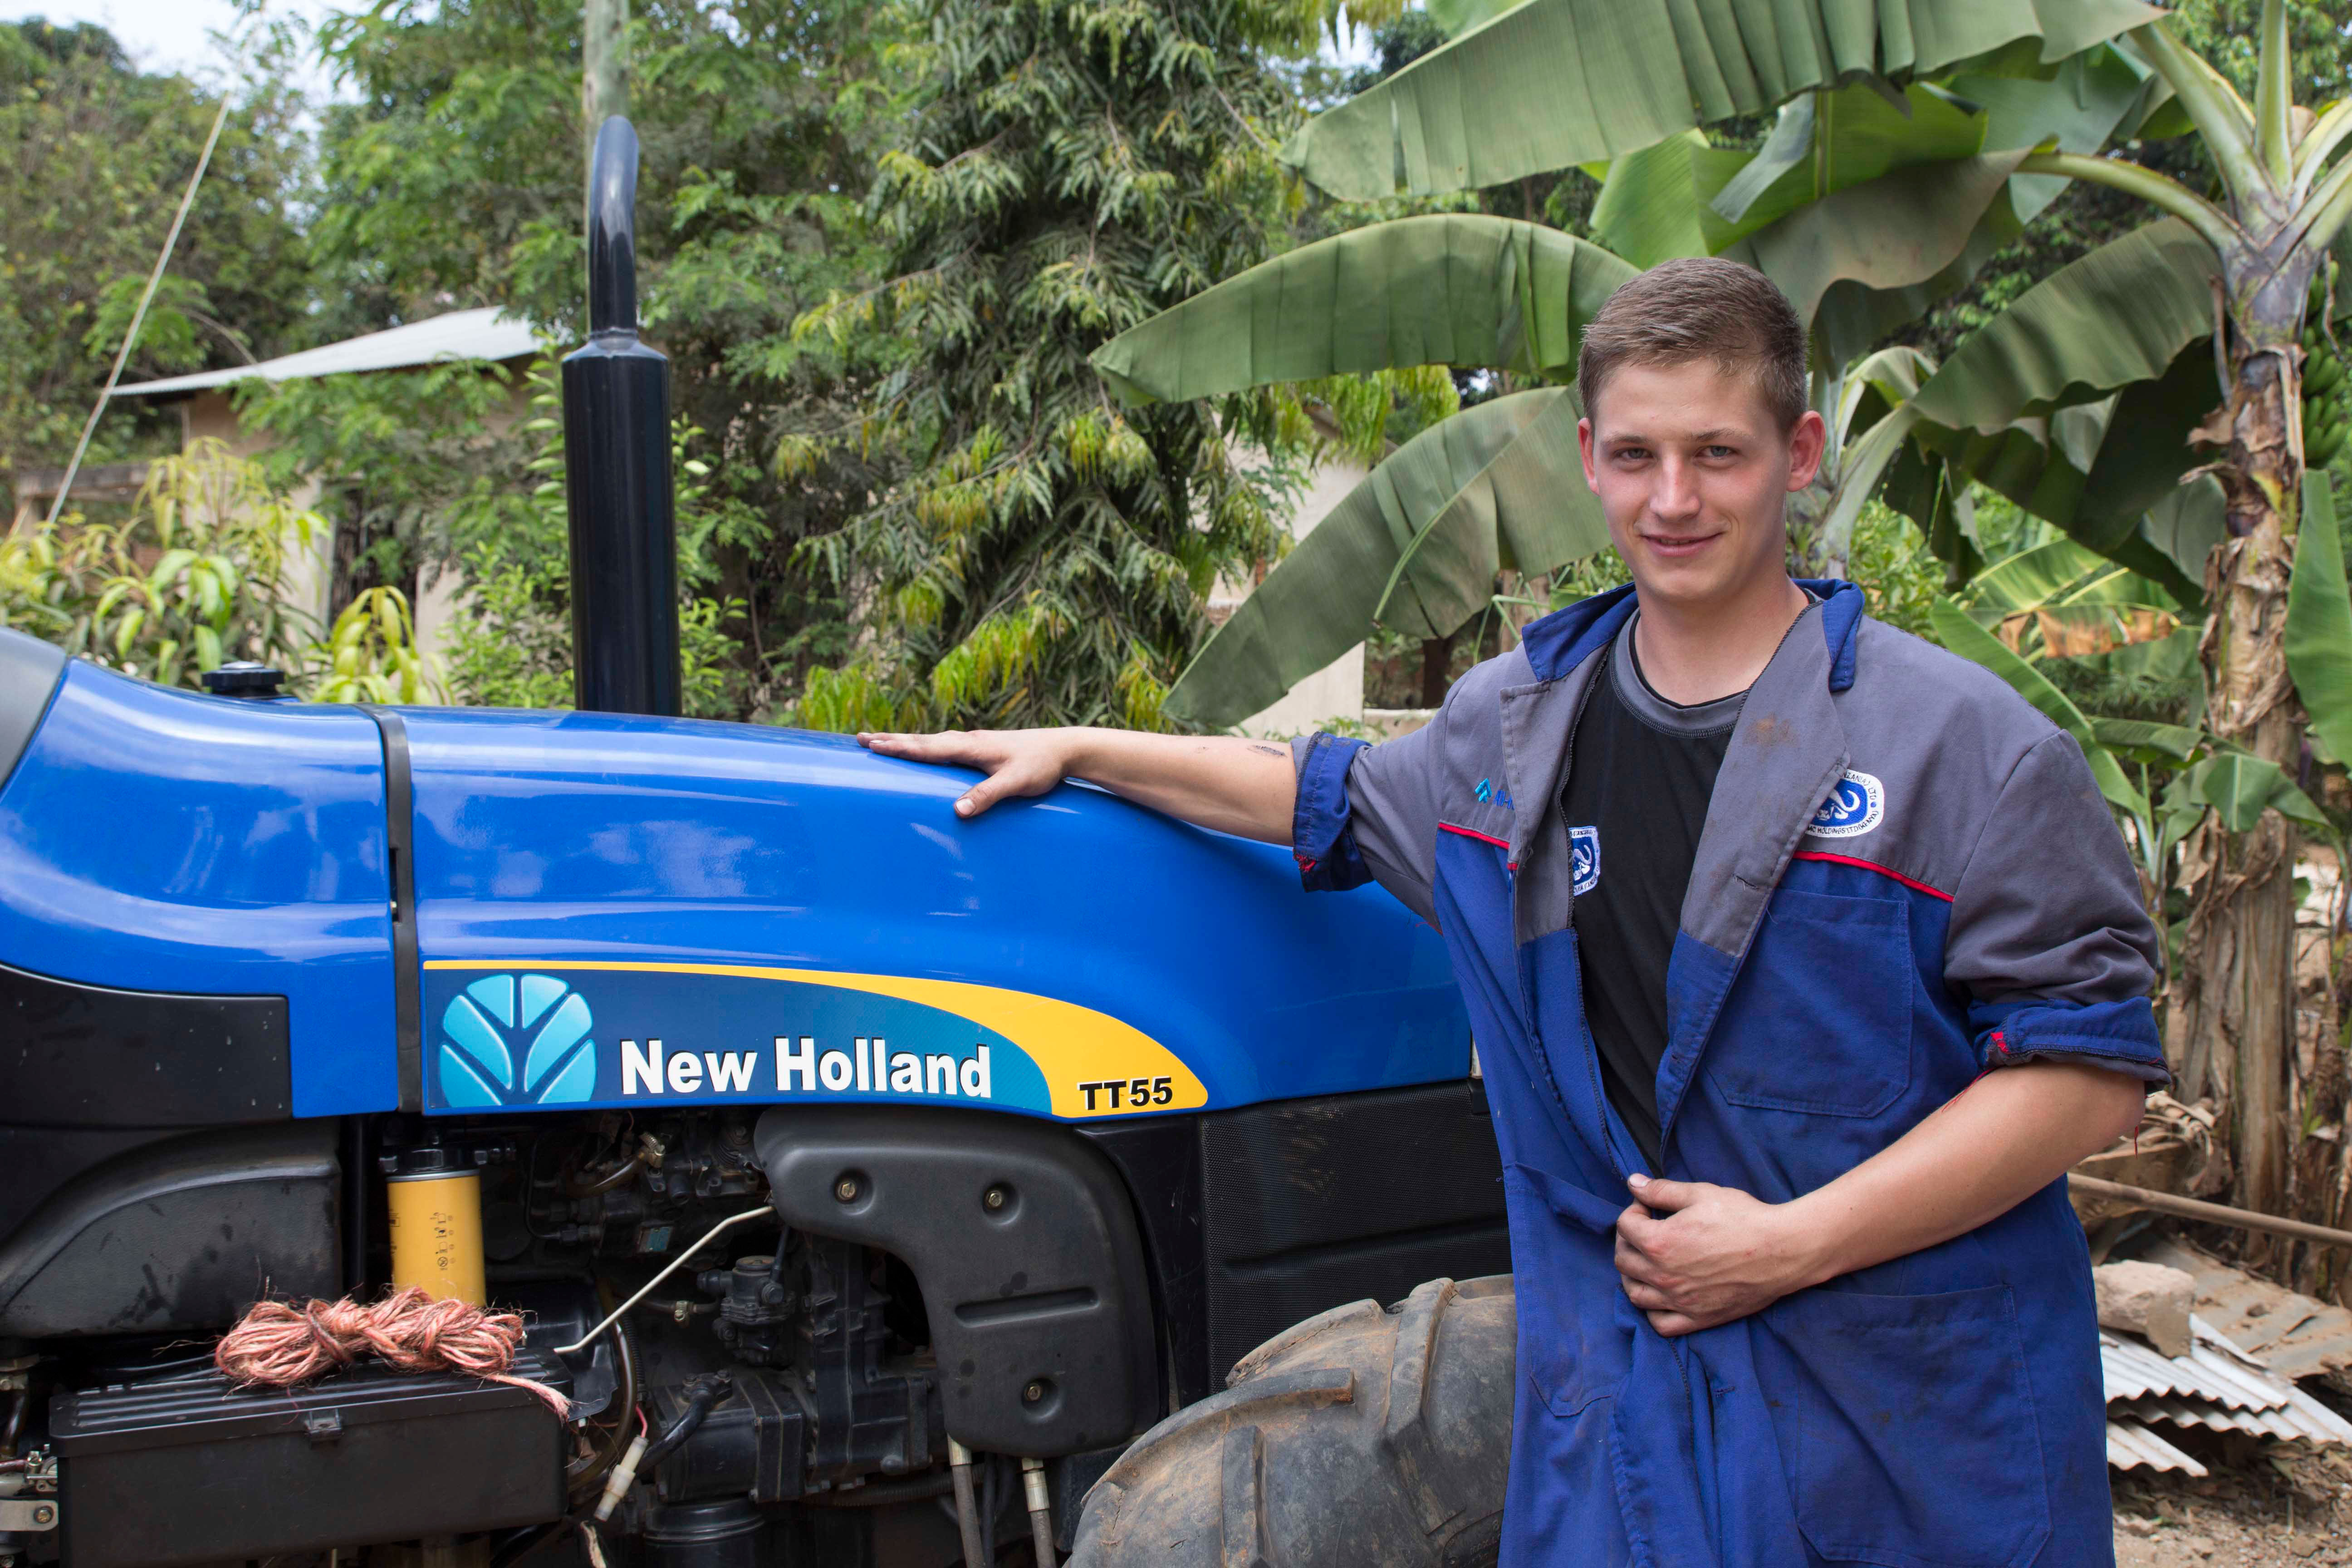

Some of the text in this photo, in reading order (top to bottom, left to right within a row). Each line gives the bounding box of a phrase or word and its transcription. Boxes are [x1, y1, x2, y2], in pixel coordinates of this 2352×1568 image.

[620, 1036, 991, 1098] New Holland
[1077, 1076, 1173, 1110] TT55
